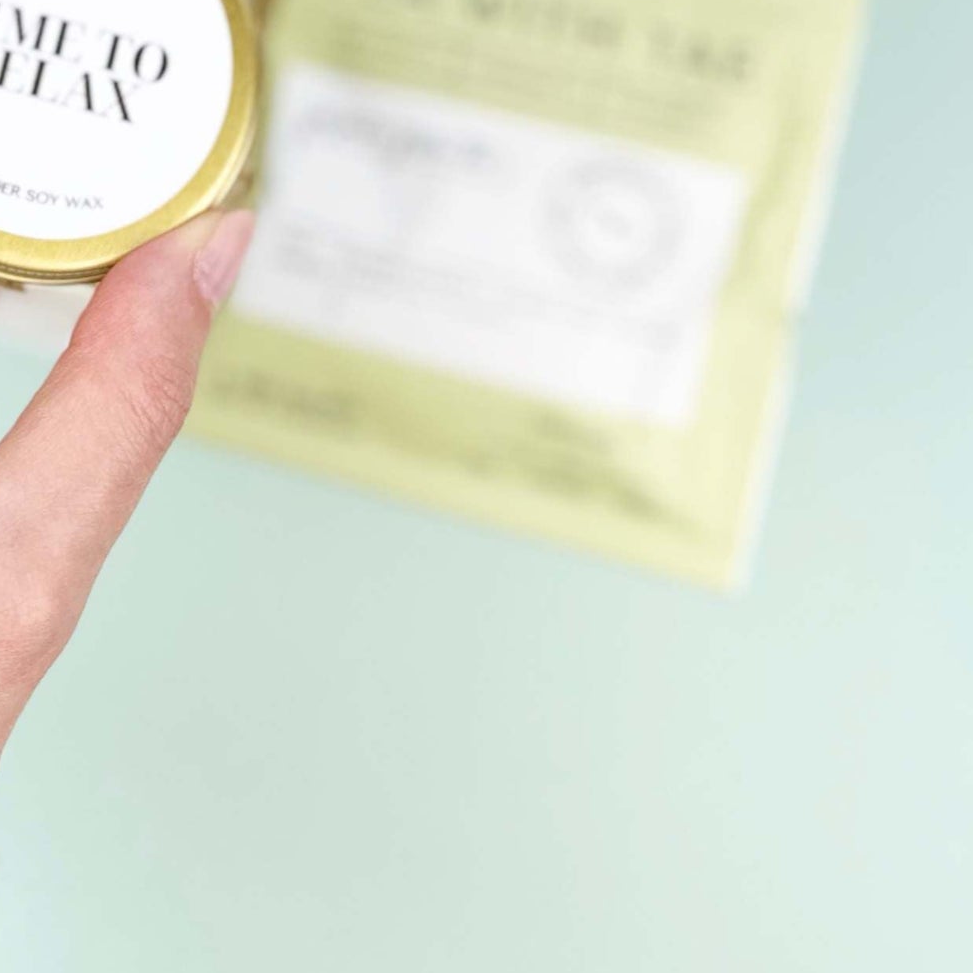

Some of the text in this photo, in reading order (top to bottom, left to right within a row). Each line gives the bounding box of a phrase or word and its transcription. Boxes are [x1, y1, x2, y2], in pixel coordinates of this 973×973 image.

[98, 30, 169, 83] TO
[26, 189, 59, 205] SOY
[65, 196, 104, 210] WAX
